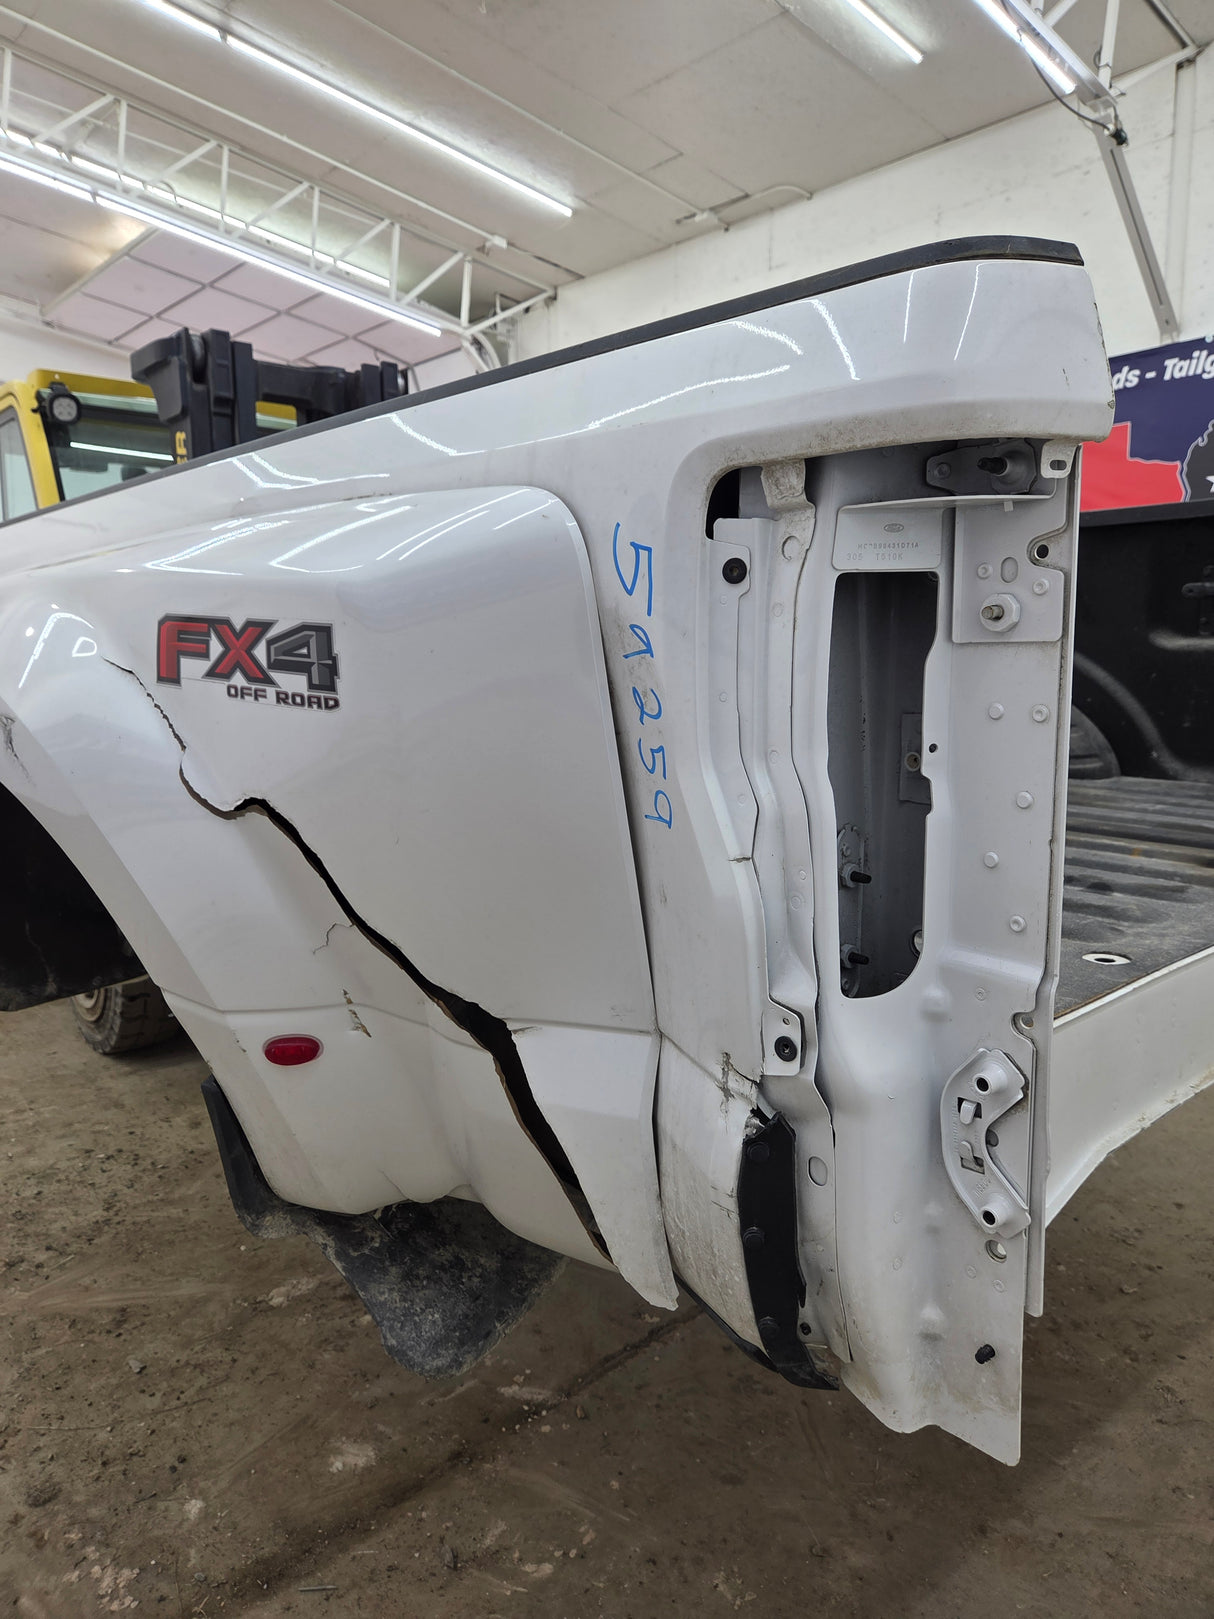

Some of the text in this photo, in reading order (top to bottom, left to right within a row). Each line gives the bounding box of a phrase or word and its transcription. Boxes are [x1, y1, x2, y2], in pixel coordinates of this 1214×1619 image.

[156, 613, 341, 695] FX4
[613, 522, 672, 829] 59259
[226, 683, 341, 711] OFF ROAD
